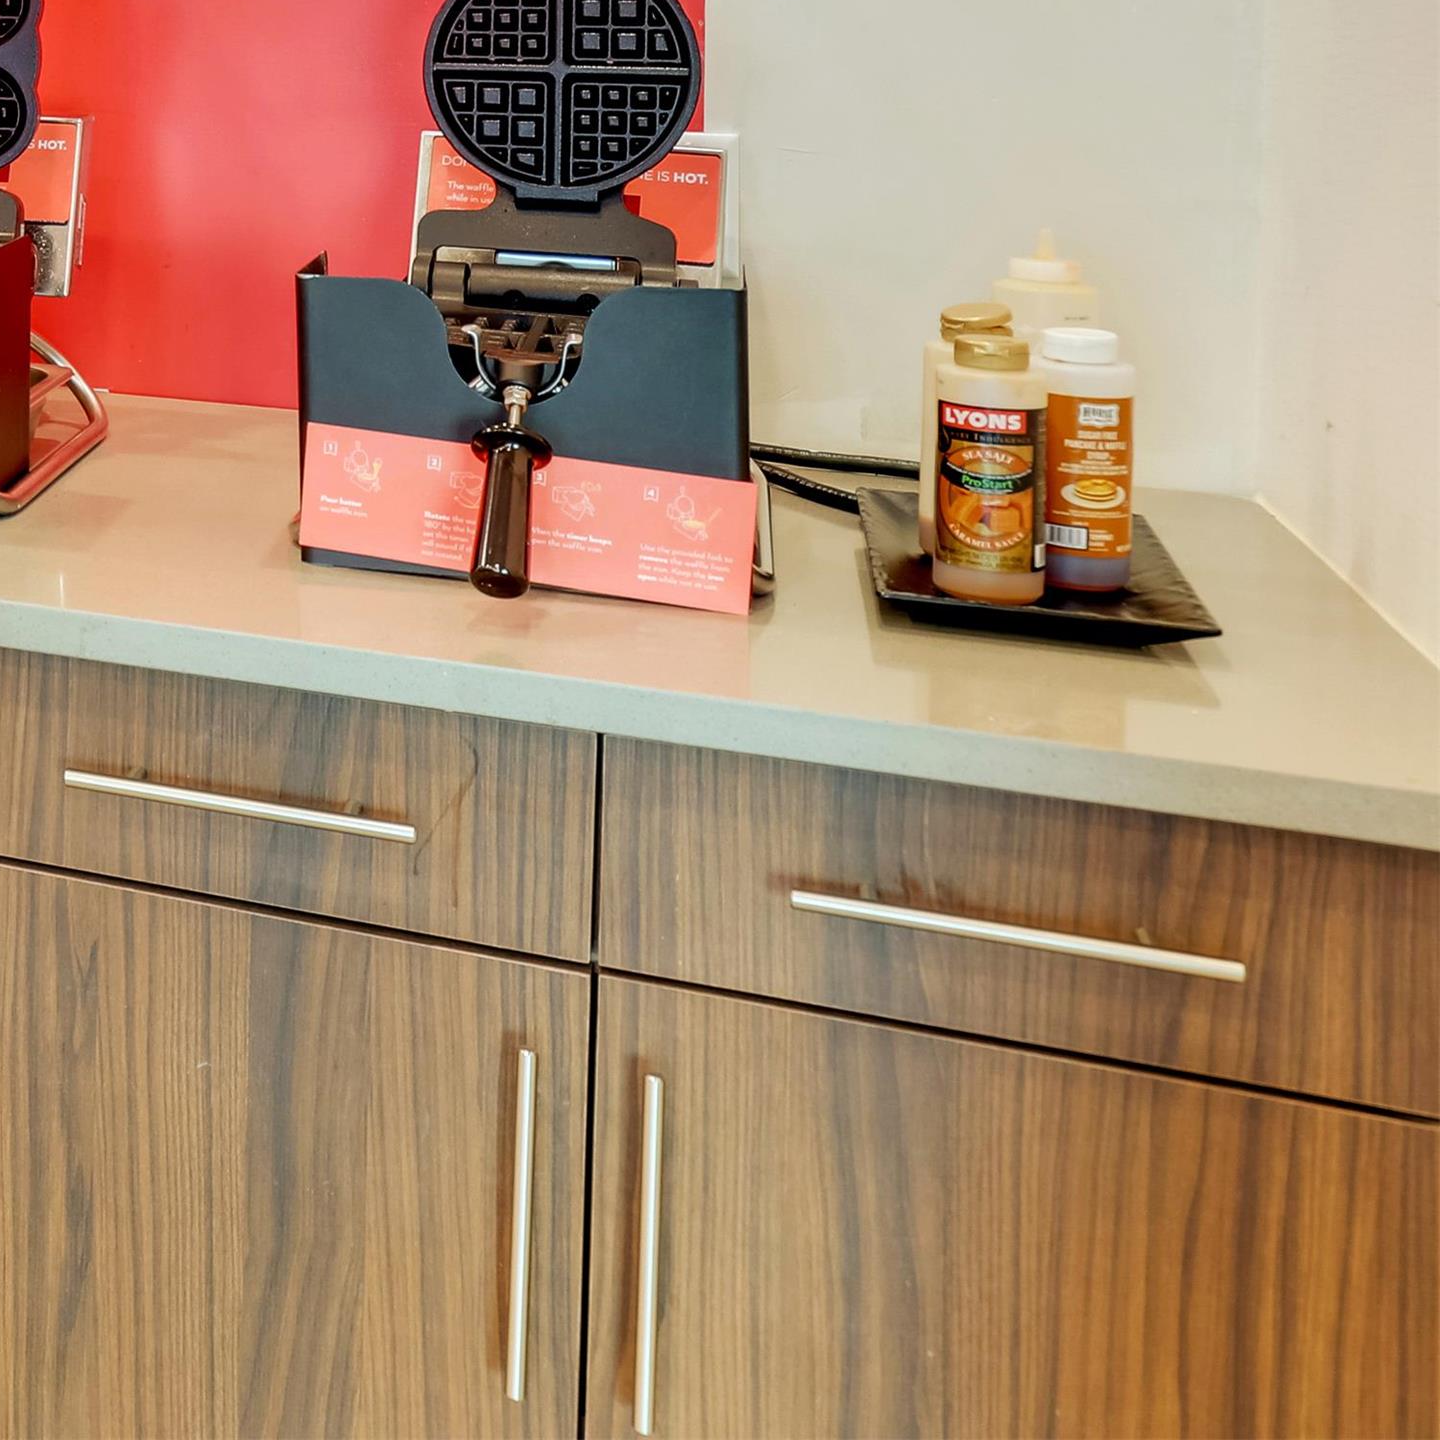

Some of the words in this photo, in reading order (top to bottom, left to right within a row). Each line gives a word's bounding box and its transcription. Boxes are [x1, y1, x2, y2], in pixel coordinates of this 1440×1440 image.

[38, 140, 67, 151] HOT.
[448, 181, 464, 190] The
[657, 171, 669, 182] IS
[673, 172, 708, 185] HOT.
[945, 407, 1021, 430] LYONS
[962, 450, 982, 461] SEA
[983, 450, 1014, 465] SALT
[961, 474, 1013, 490] ProStart
[949, 522, 992, 549] CARAMEL
[995, 531, 1025, 549] SAUCE
